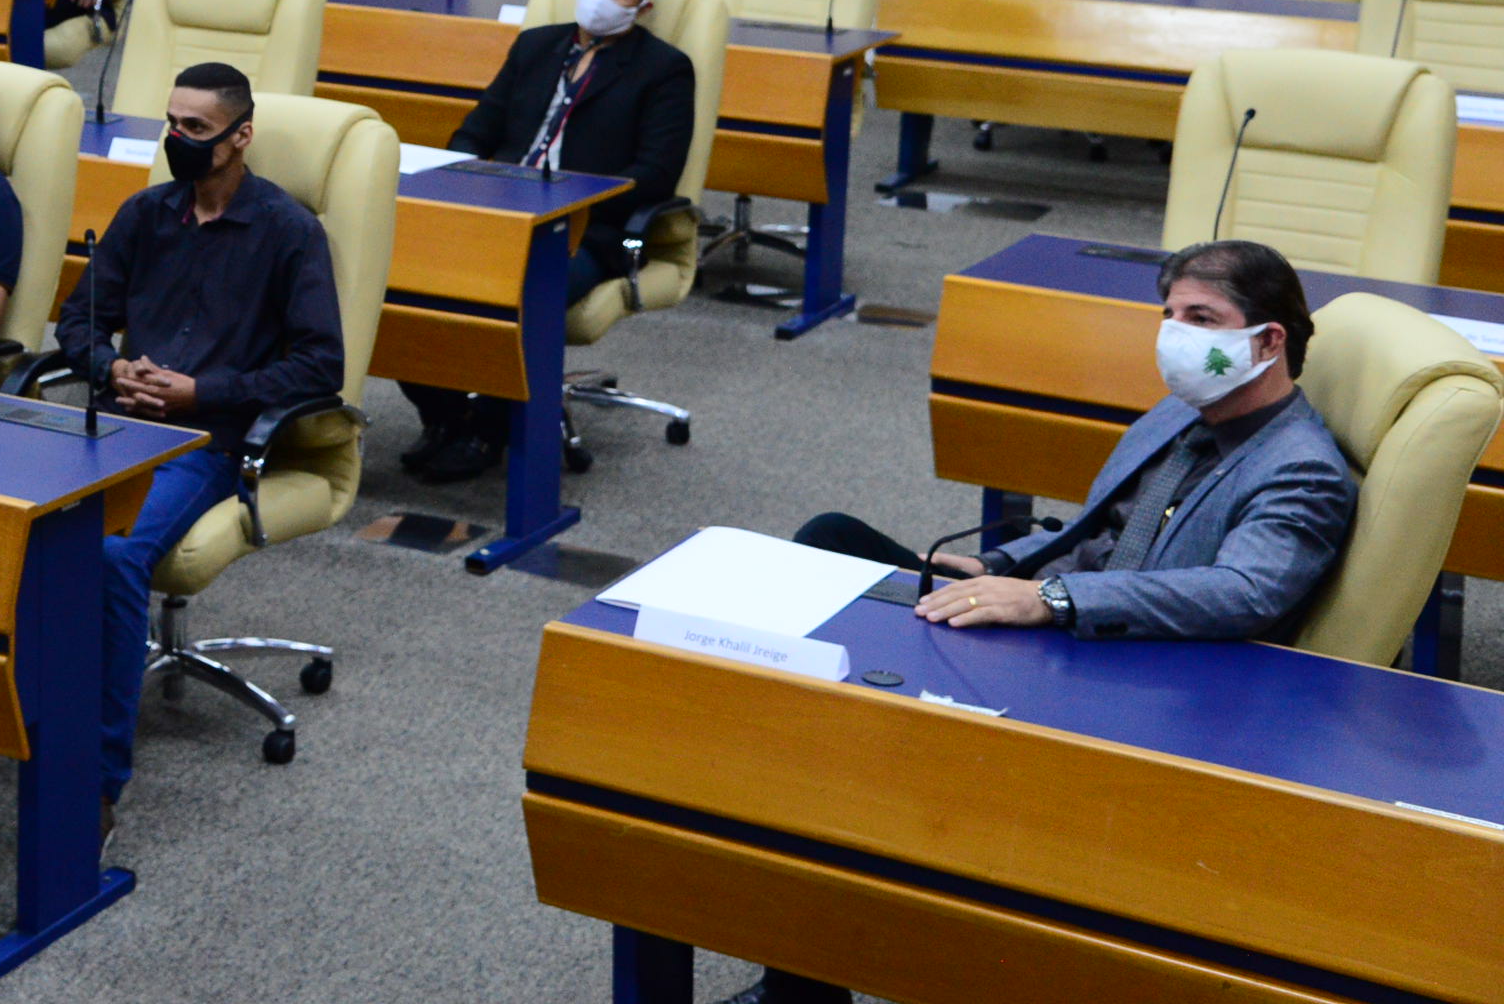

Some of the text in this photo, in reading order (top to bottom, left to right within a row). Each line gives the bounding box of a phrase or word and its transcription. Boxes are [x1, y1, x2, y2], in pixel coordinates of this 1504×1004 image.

[685, 630, 788, 663] Jorge Khalil Jreige
